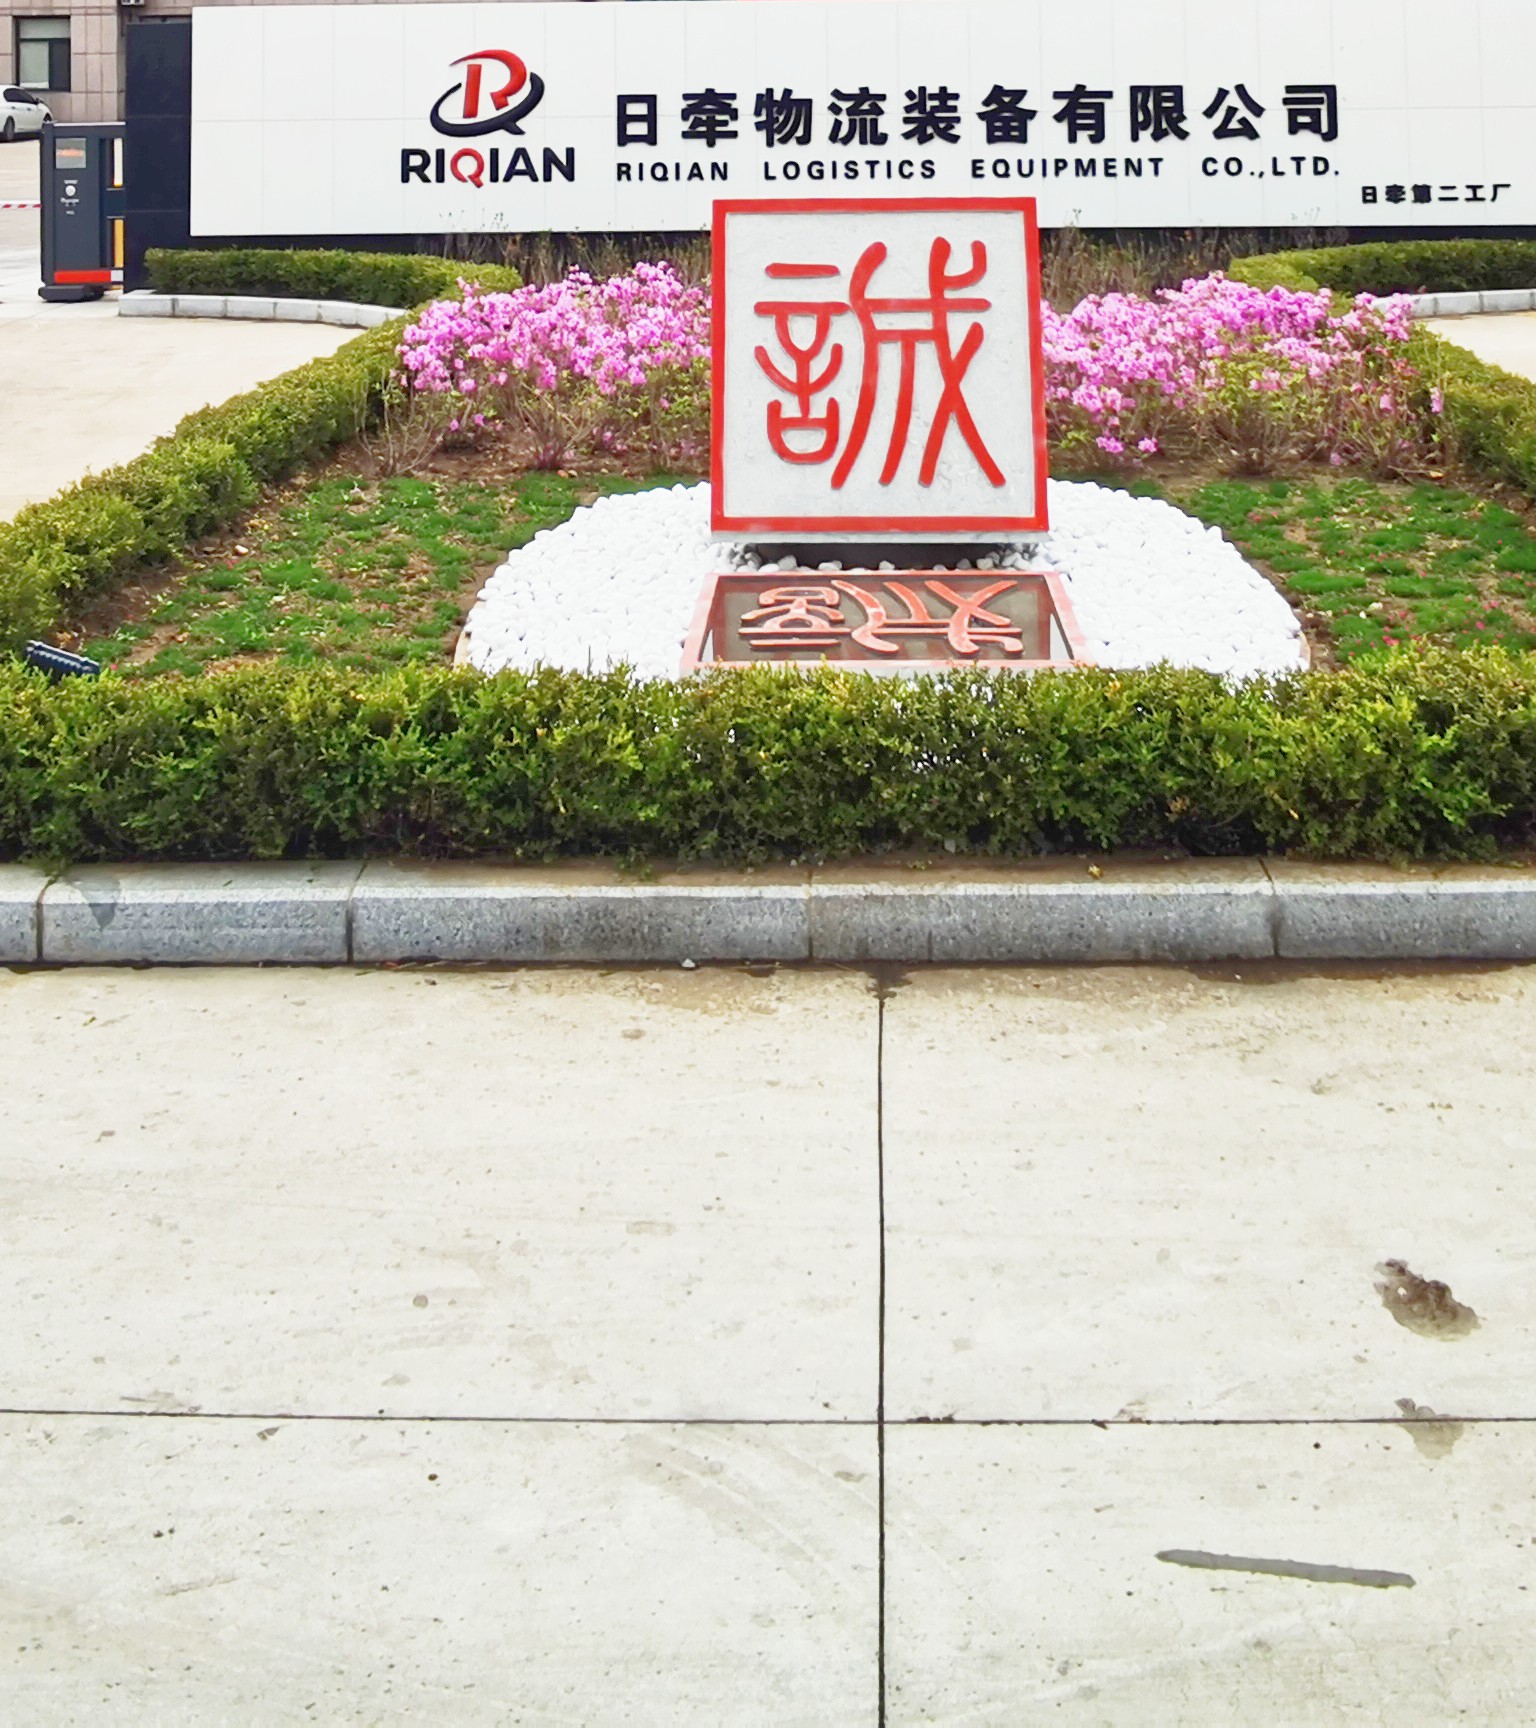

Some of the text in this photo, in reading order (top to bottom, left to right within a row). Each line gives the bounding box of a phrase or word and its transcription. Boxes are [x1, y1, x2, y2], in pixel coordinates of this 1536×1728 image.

[615, 83, 1340, 149] 日牵物流装备有限公司
[400, 146, 576, 188] RIQIAN
[616, 155, 1340, 182] RIQIAN LOGISTICS EQUIPMENT CO.,LTD.
